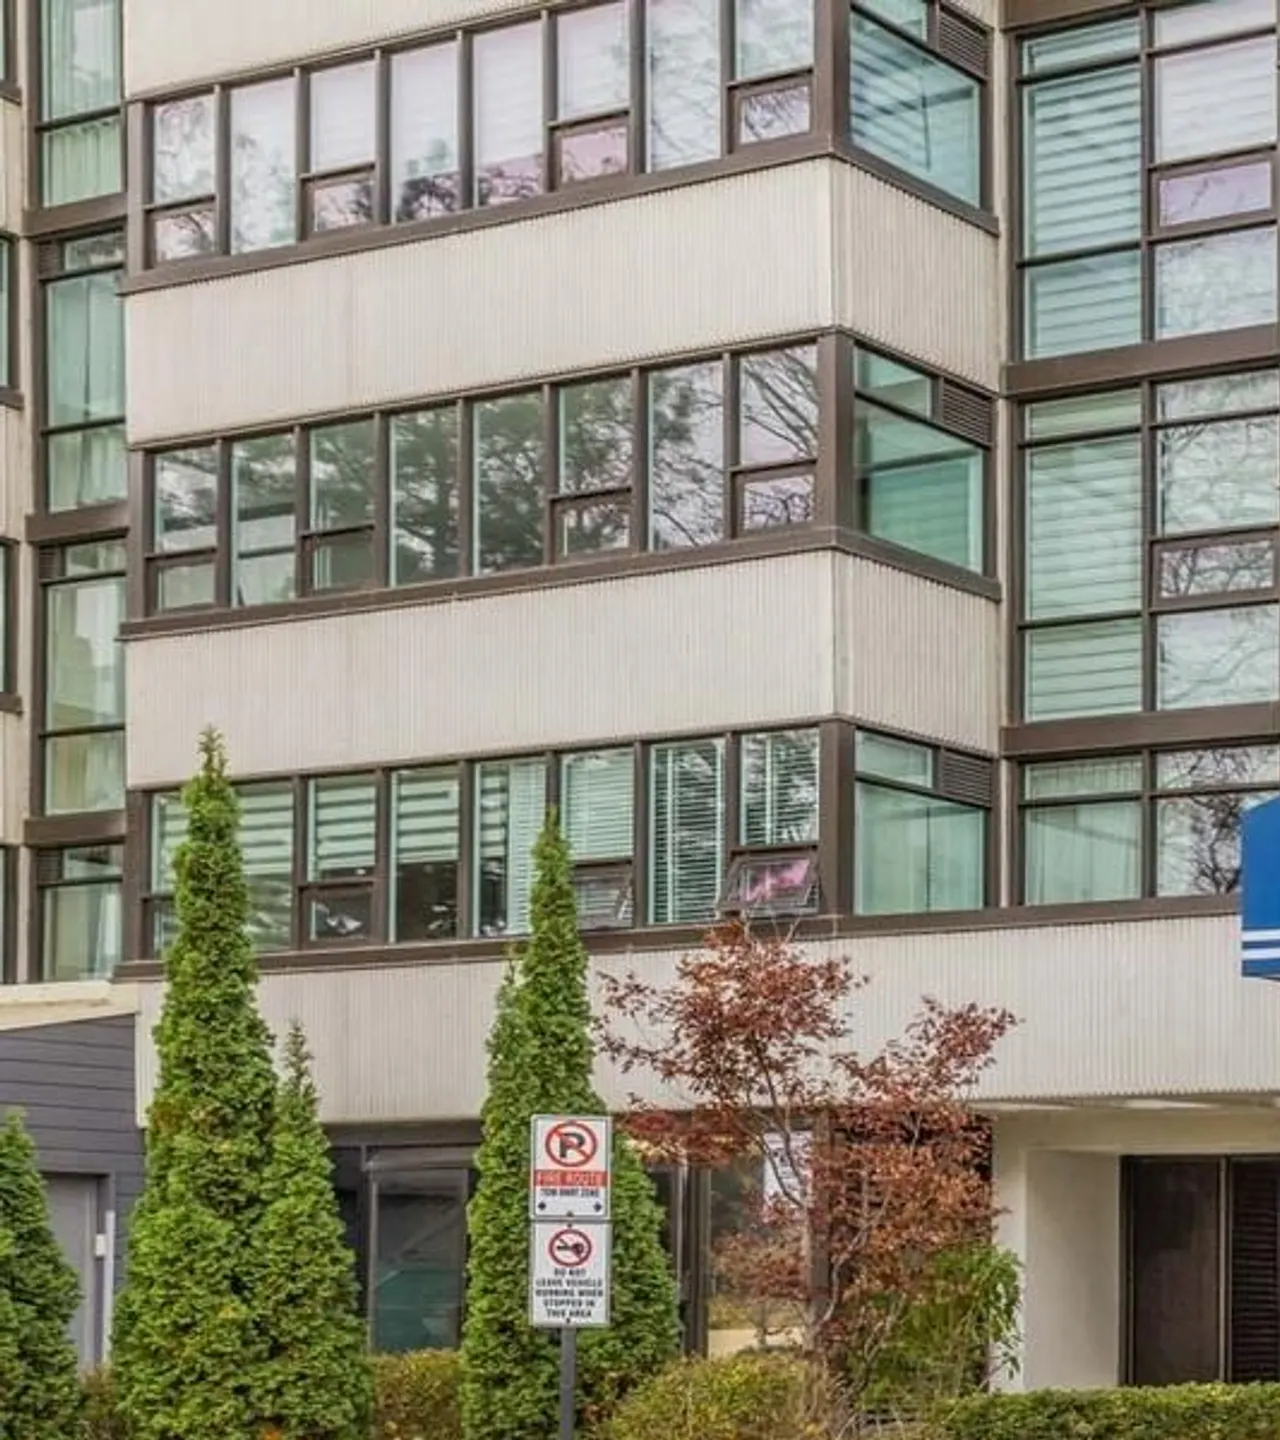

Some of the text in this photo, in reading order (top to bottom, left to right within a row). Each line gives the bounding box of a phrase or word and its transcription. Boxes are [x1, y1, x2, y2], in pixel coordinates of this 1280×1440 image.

[536, 1171, 603, 1186] FIRE ROUTE
[554, 1268, 587, 1276] DO NOT
[535, 1278, 603, 1287] LEAVE VEHICLE
[535, 1289, 604, 1297] RUNNING WHEN
[543, 1299, 596, 1307] STOPPED IN
[546, 1309, 592, 1318] THIS AREA
